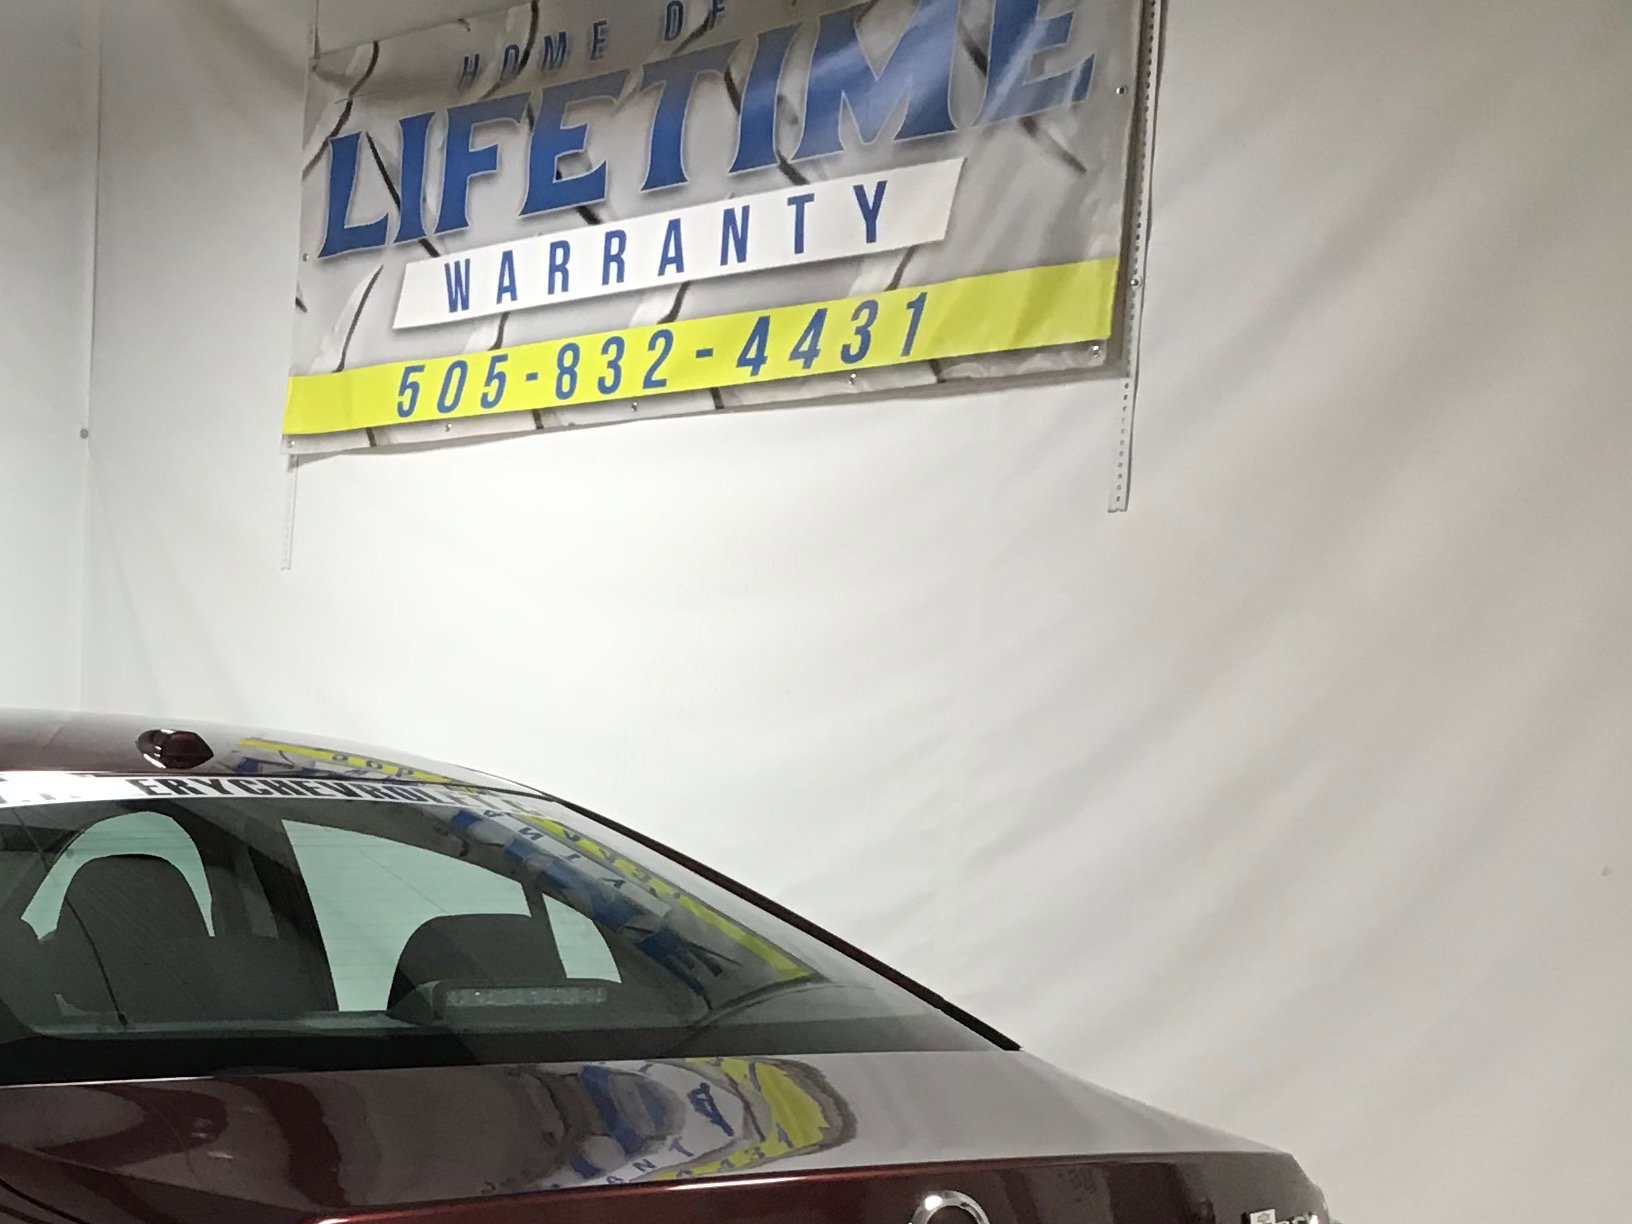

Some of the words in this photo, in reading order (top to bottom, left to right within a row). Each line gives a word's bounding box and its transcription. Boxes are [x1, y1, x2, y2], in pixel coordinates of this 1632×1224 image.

[457, 20, 608, 87] HOME
[318, 0, 1095, 260] LIFETIME
[445, 180, 887, 313] WARRANTY
[397, 291, 928, 418] 505-832-4431
